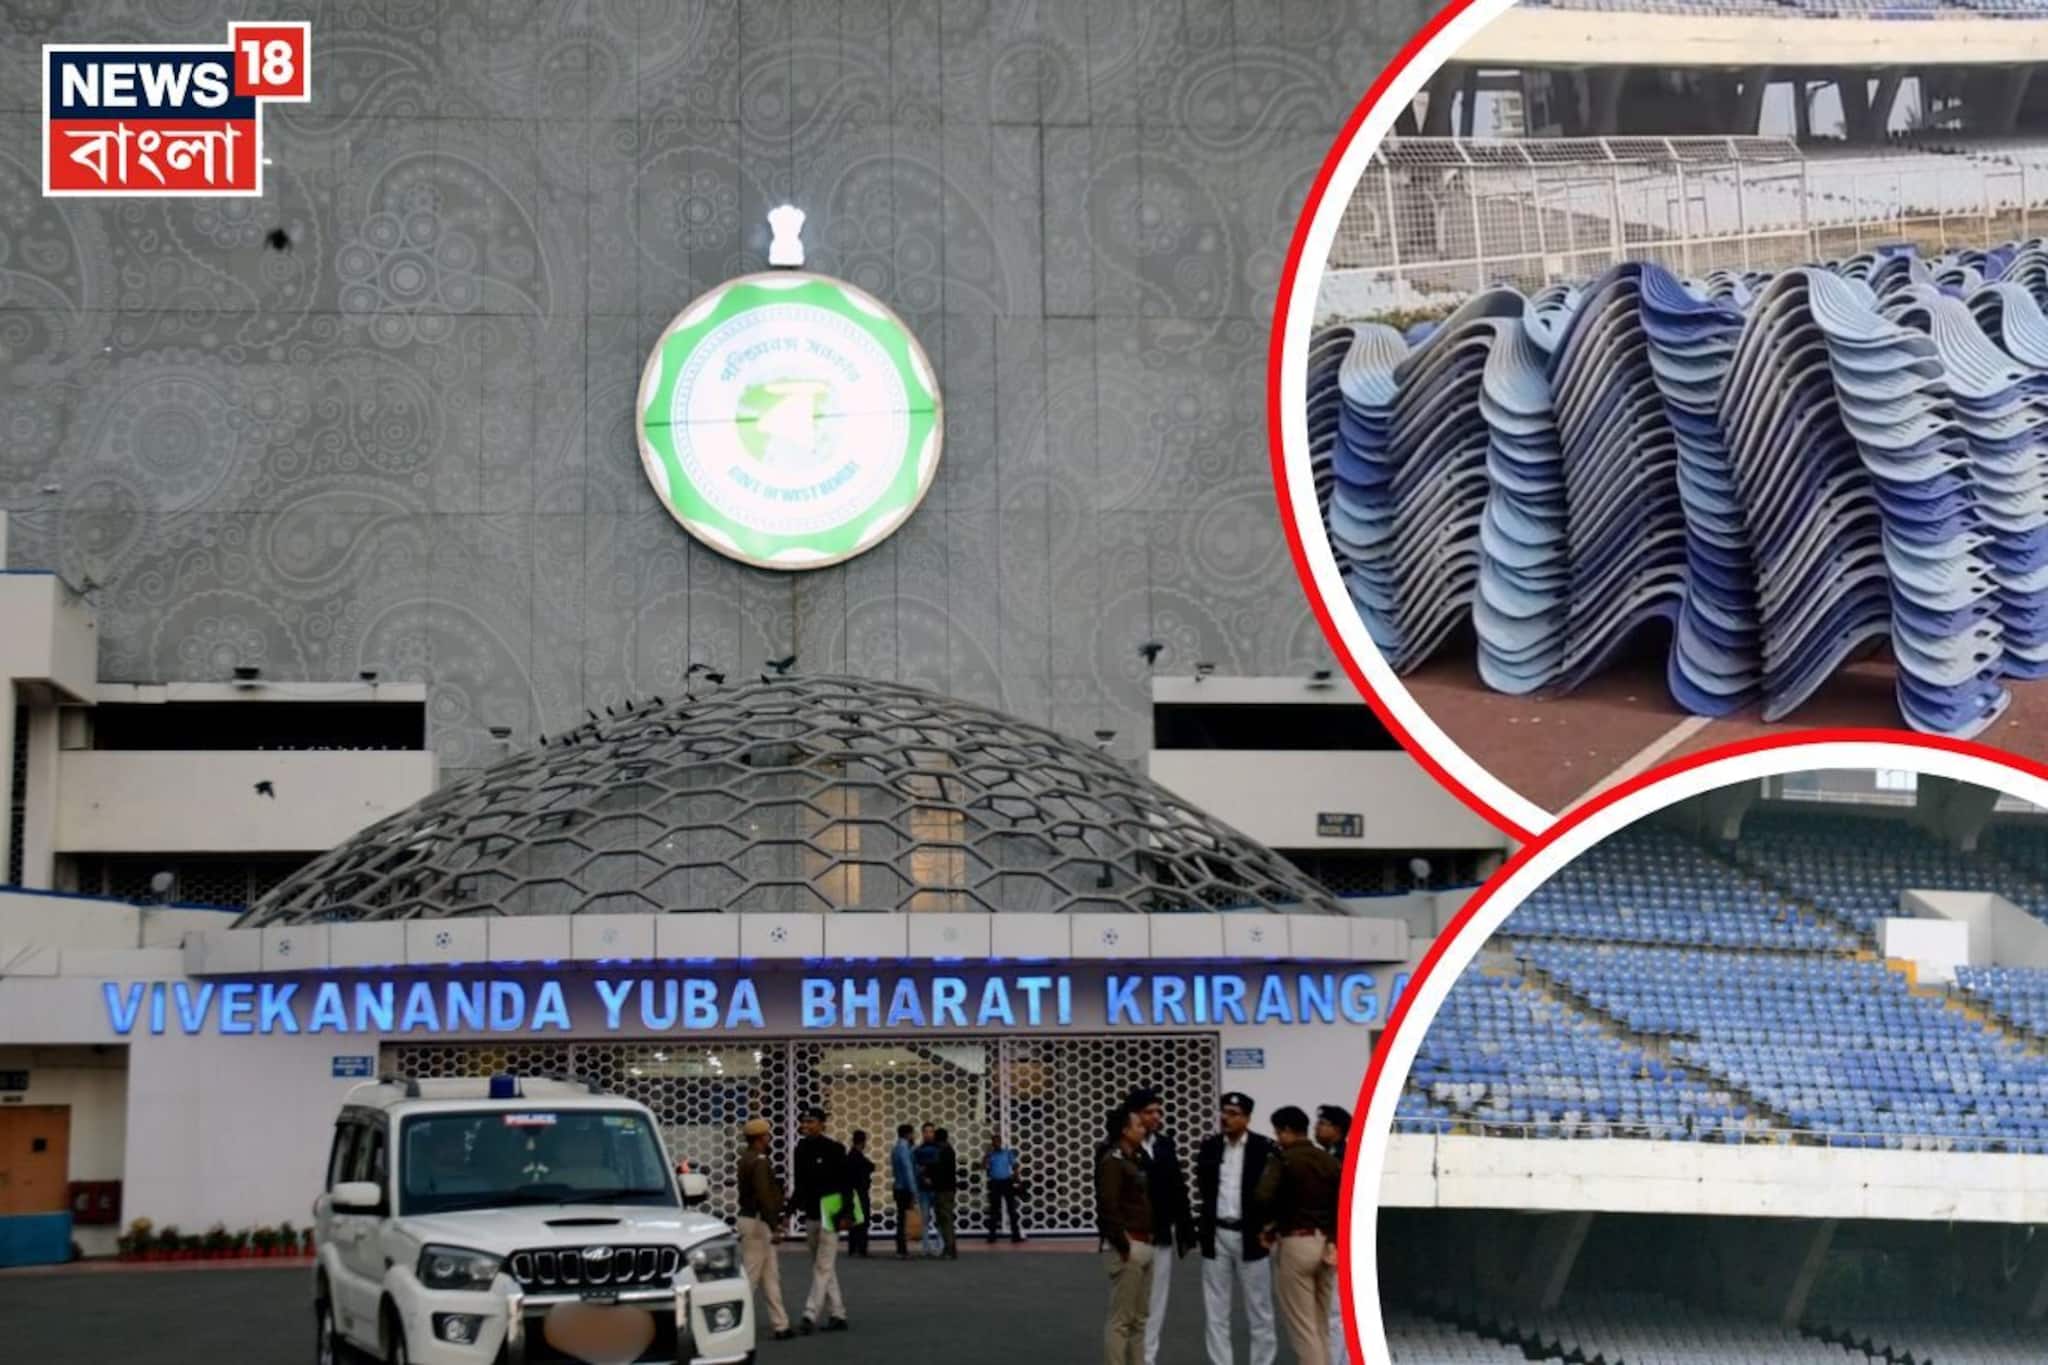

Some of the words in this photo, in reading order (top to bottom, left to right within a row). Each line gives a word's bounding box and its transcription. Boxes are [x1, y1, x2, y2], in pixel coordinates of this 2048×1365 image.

[102, 980, 572, 1034] VIVEKANANDA
[594, 976, 766, 1032] YUBA
[800, 974, 1074, 1030] BHARATI
